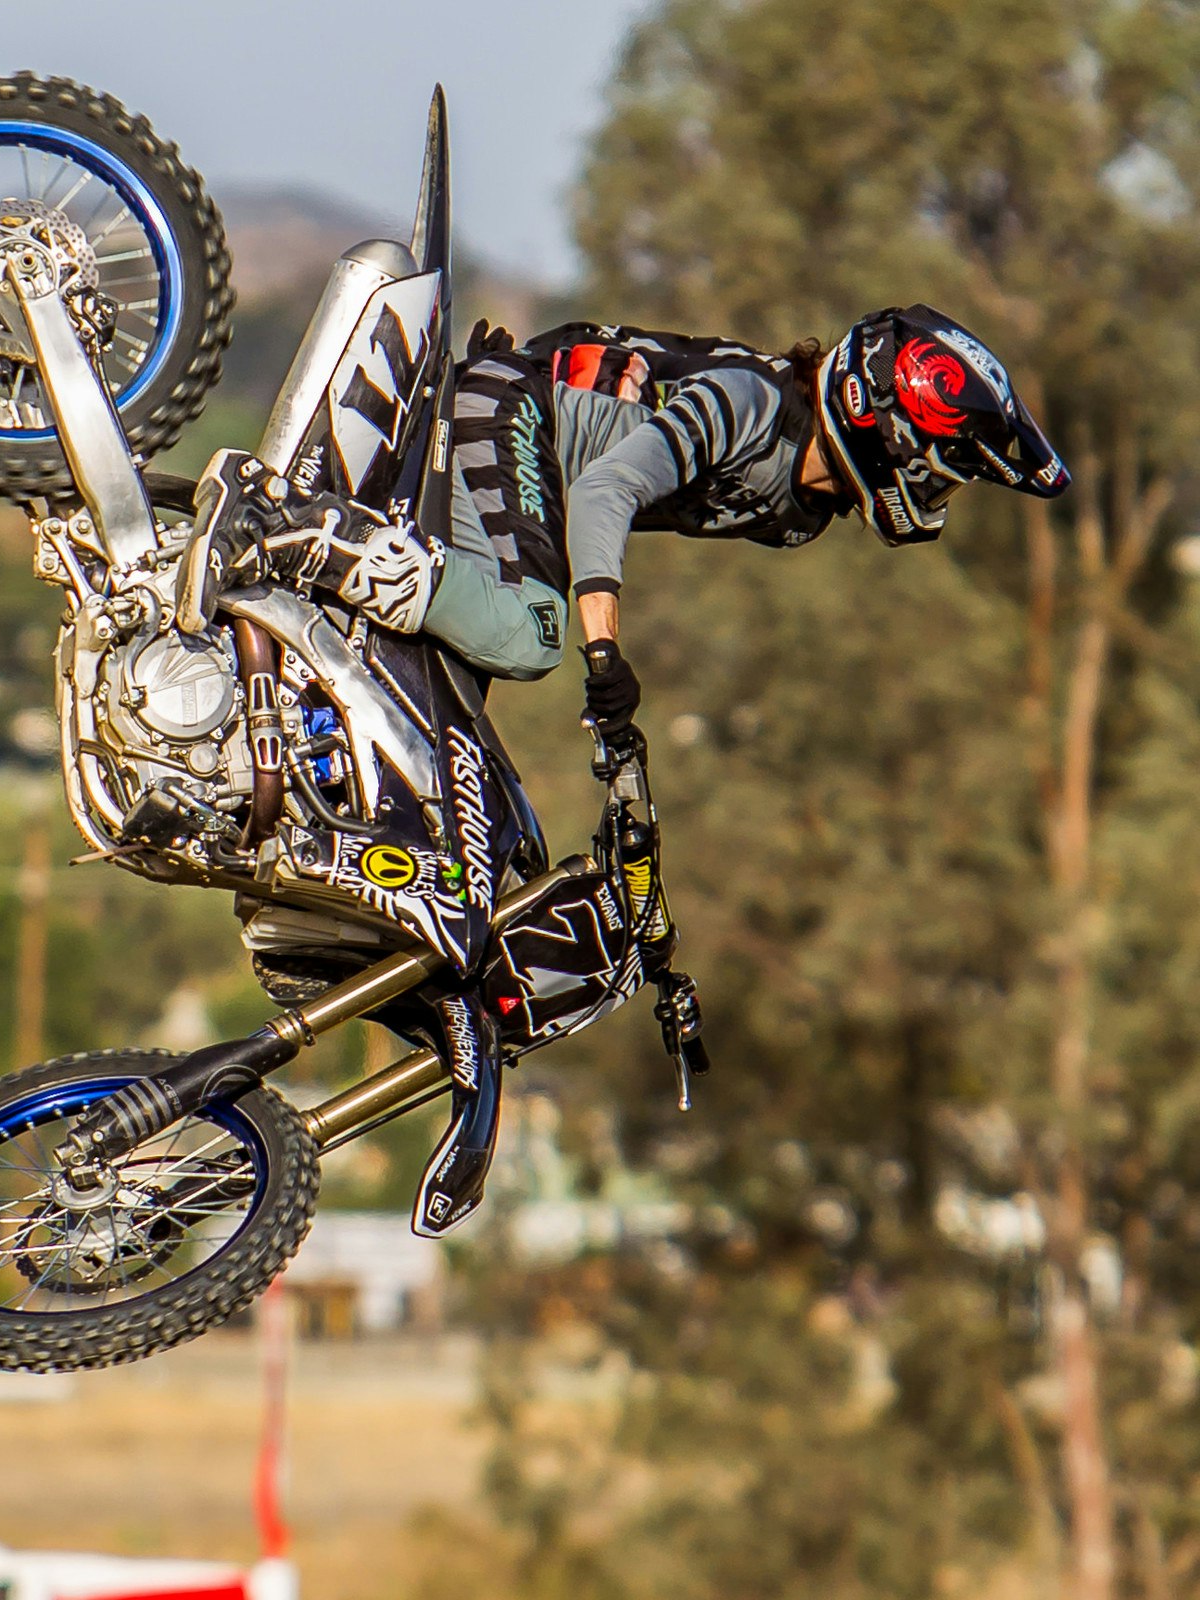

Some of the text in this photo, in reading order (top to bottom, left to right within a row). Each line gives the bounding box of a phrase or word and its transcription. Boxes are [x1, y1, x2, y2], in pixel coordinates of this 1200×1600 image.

[849, 380, 861, 410] BELL
[293, 458, 322, 488] VIEW
[878, 486, 915, 535] DRAGON
[447, 726, 493, 923] FASTHOUSE
[405, 846, 437, 900] SMILES
[595, 881, 624, 932] EVANS
[157, 1078, 183, 1114] ACERB
